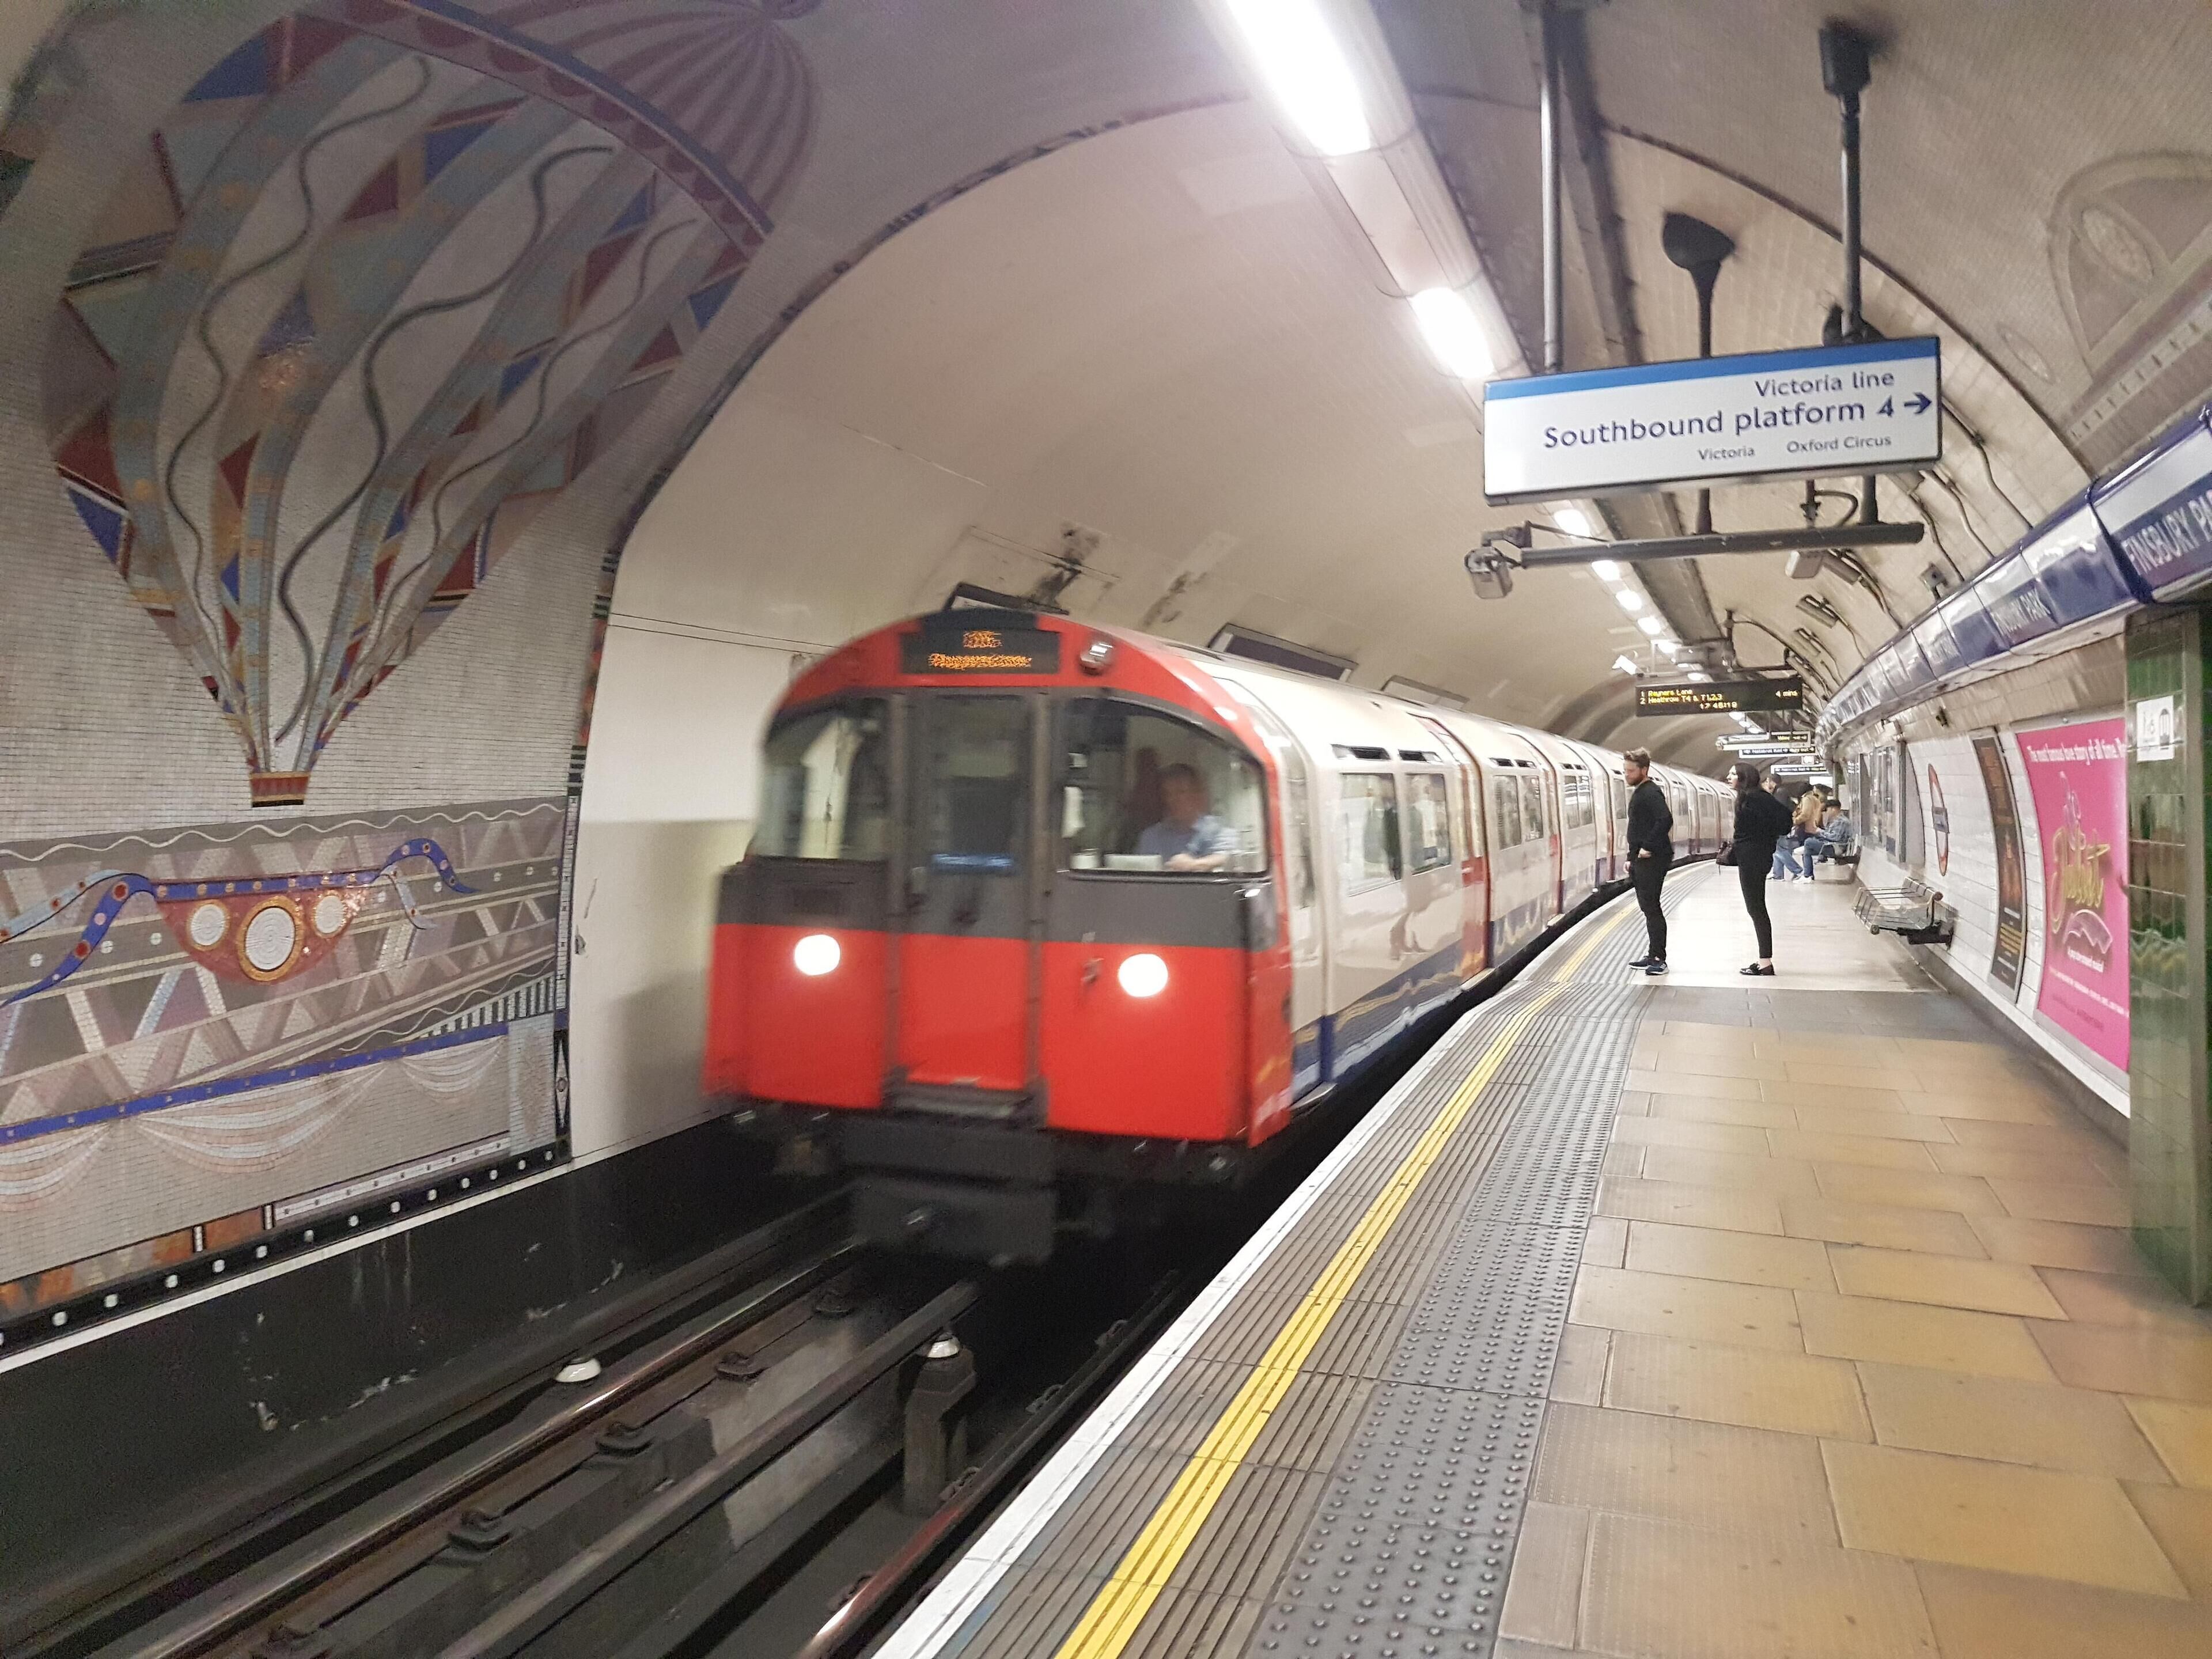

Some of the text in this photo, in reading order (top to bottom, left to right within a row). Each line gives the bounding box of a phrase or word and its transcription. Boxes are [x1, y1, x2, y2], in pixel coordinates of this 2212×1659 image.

[1755, 372, 1894, 396] Victoria line
[1544, 395, 1894, 448] Southbound platform 4
[1698, 435, 1892, 460] Victoria Oxford Circus
[2121, 507, 2199, 575] FINSBURY
[1648, 696, 1679, 704] Heathrow
